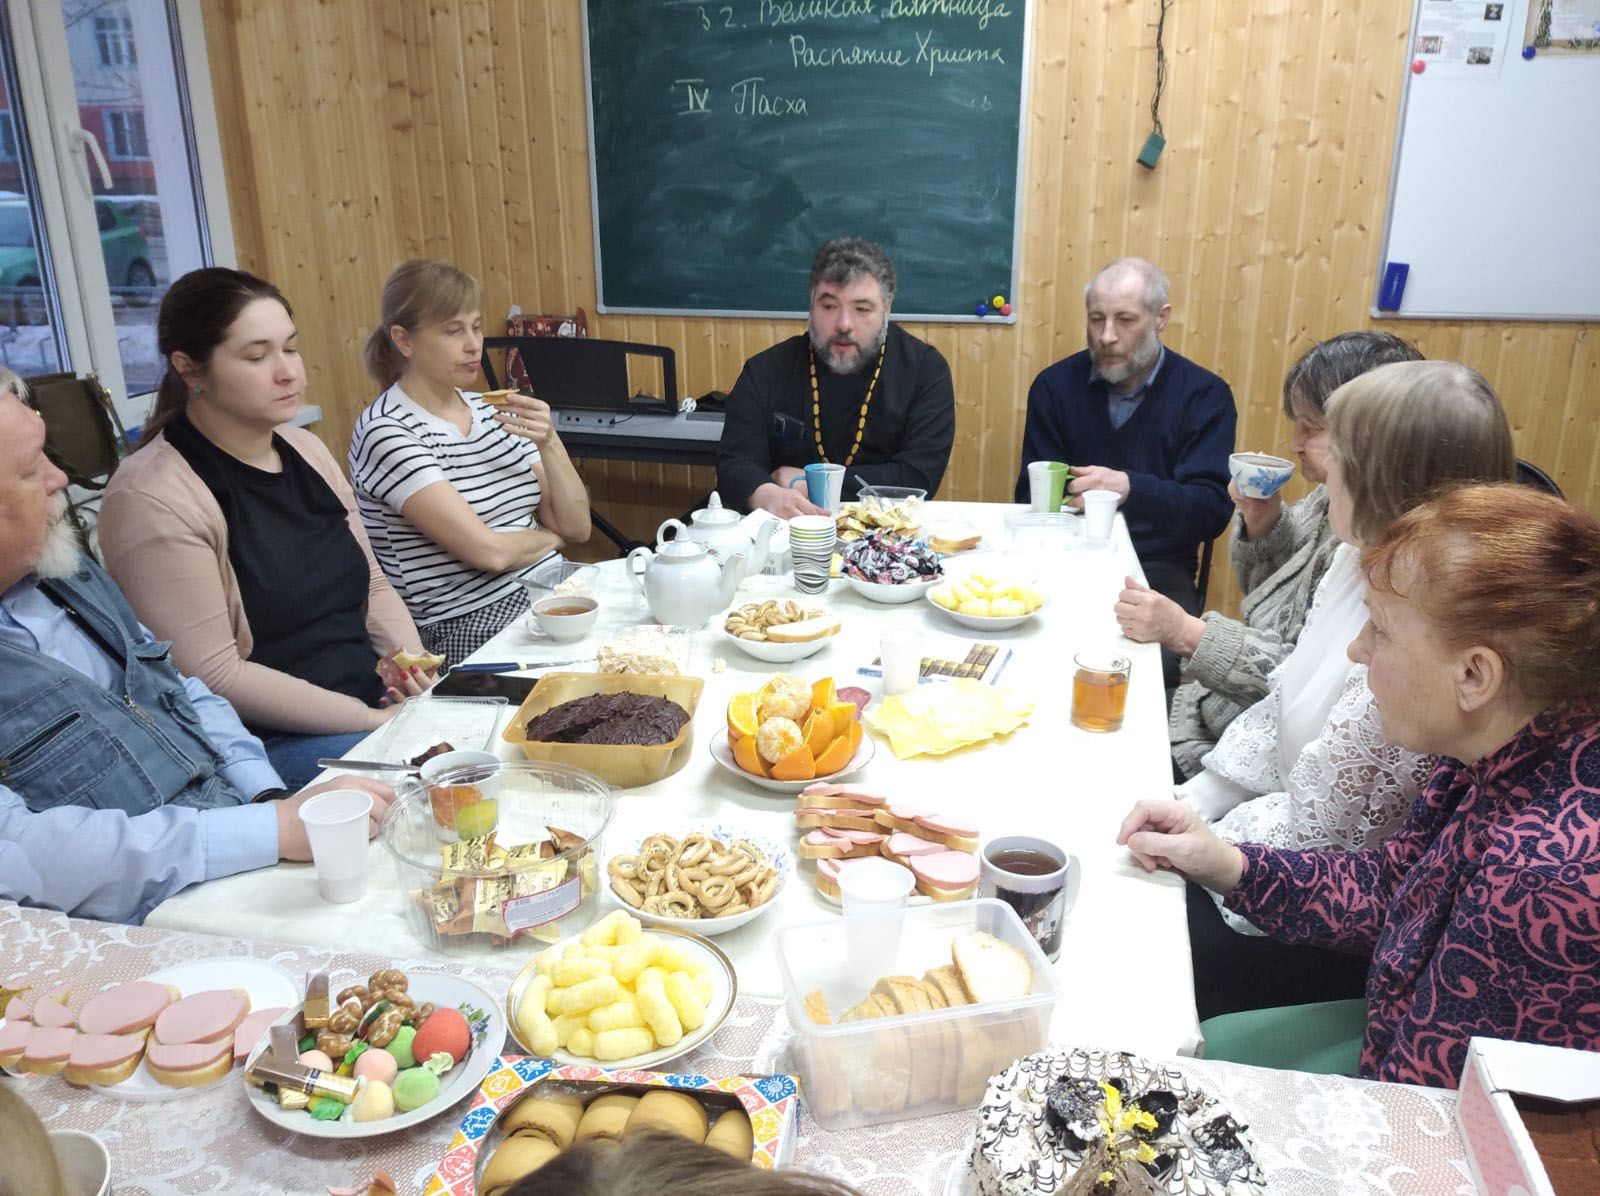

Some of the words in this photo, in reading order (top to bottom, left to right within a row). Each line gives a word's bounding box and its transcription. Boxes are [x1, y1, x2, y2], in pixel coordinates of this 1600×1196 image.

[719, 5, 747, 29] 2.
[790, 33, 911, 68] Распятие
[914, 29, 1005, 77] Христа
[730, 76, 809, 116] Пасха
